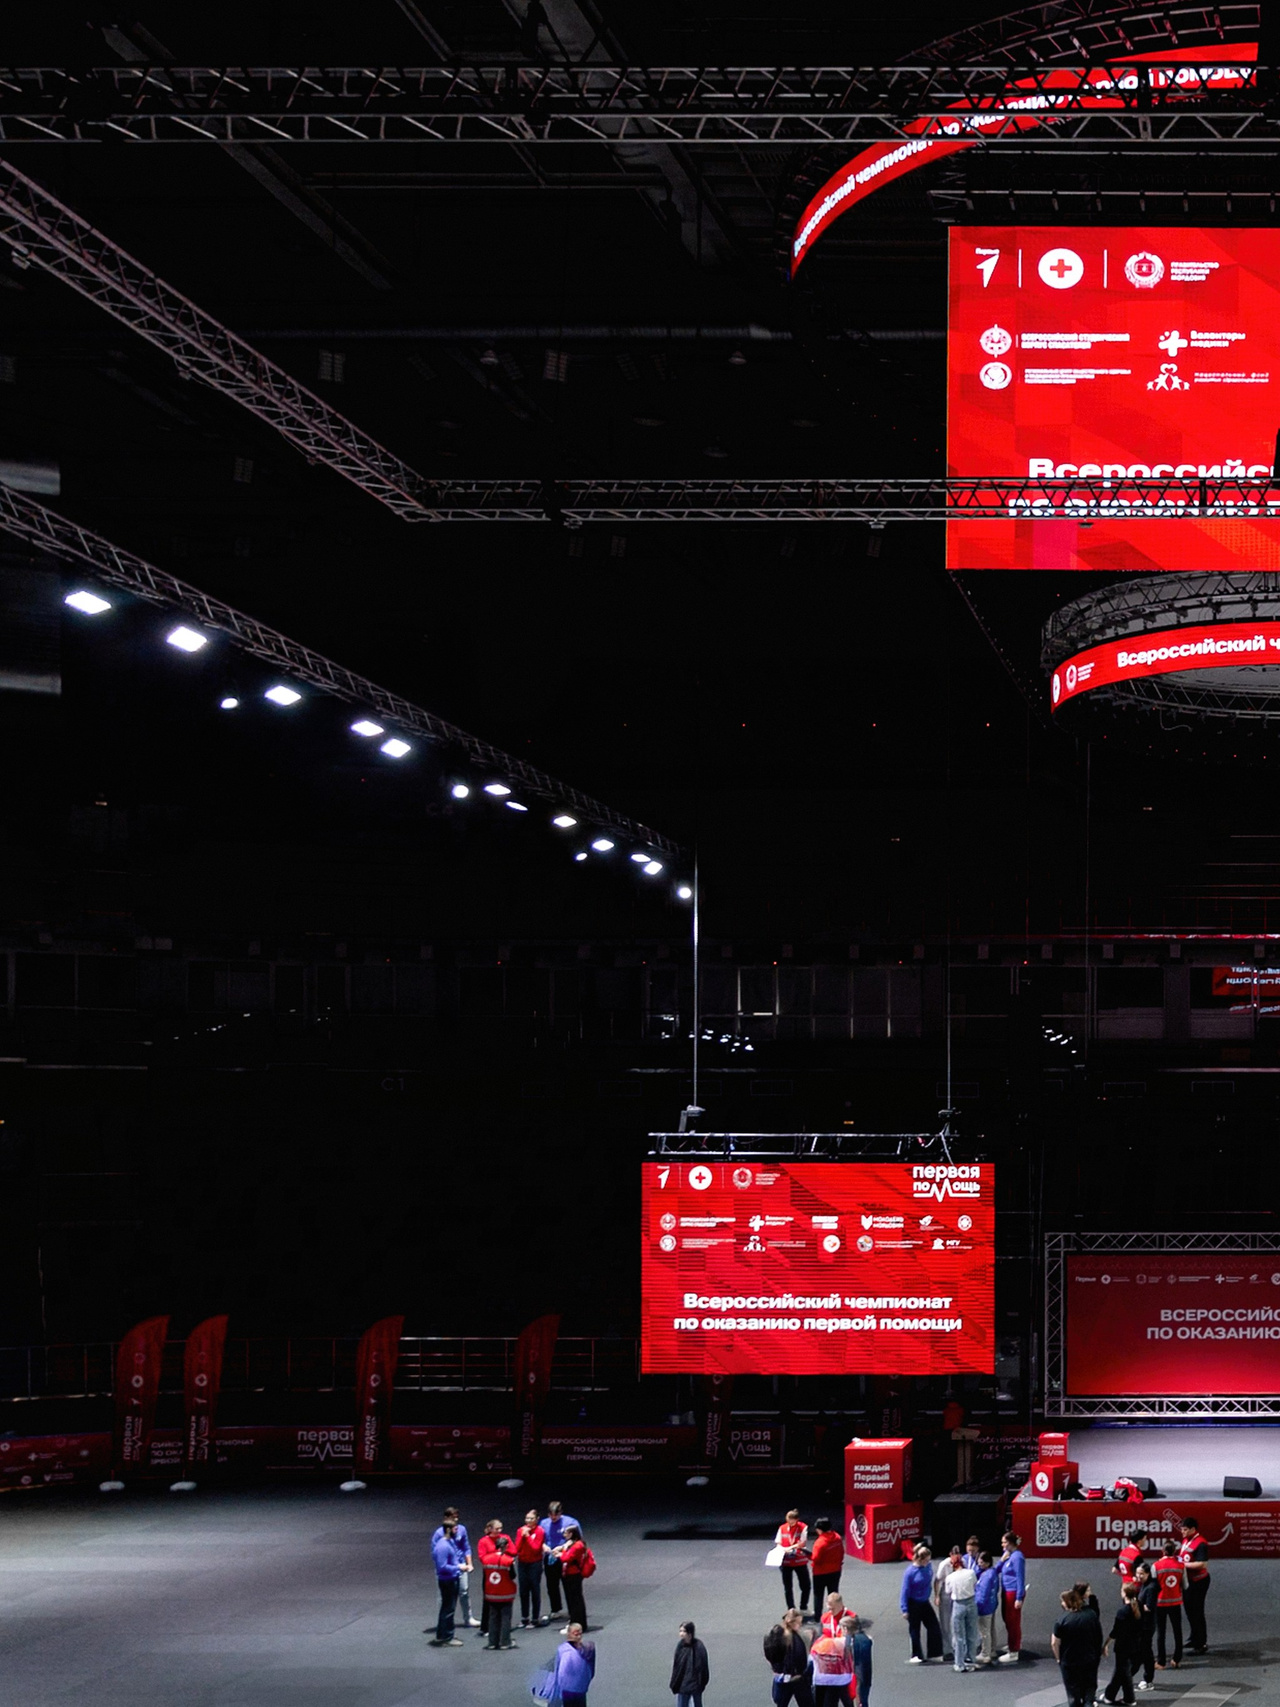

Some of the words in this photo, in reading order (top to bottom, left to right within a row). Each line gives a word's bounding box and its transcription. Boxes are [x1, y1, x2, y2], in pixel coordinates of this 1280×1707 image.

[1117, 635, 1266, 668] Всероссийский
[912, 1164, 981, 1182] первая
[683, 1293, 841, 1312] Всероссийский
[844, 1296, 952, 1310] чемпионат
[673, 1317, 699, 1331] по
[701, 1317, 802, 1331] оказанию
[803, 1314, 878, 1334] первой
[879, 1317, 962, 1332] помощи
[1146, 1327, 1173, 1340] ПО
[541, 1437, 615, 1445] ВСЕРОССИЙСКИЙ
[616, 1437, 668, 1445] ЧЕМПИОНАТ
[566, 1453, 601, 1461] ПЕРВОЙ
[602, 1454, 643, 1462] ПОМОЩИ
[853, 1463, 891, 1472] каждый
[853, 1473, 890, 1482] Первый
[876, 1516, 920, 1530] первая
[1095, 1516, 1173, 1536] Первая
